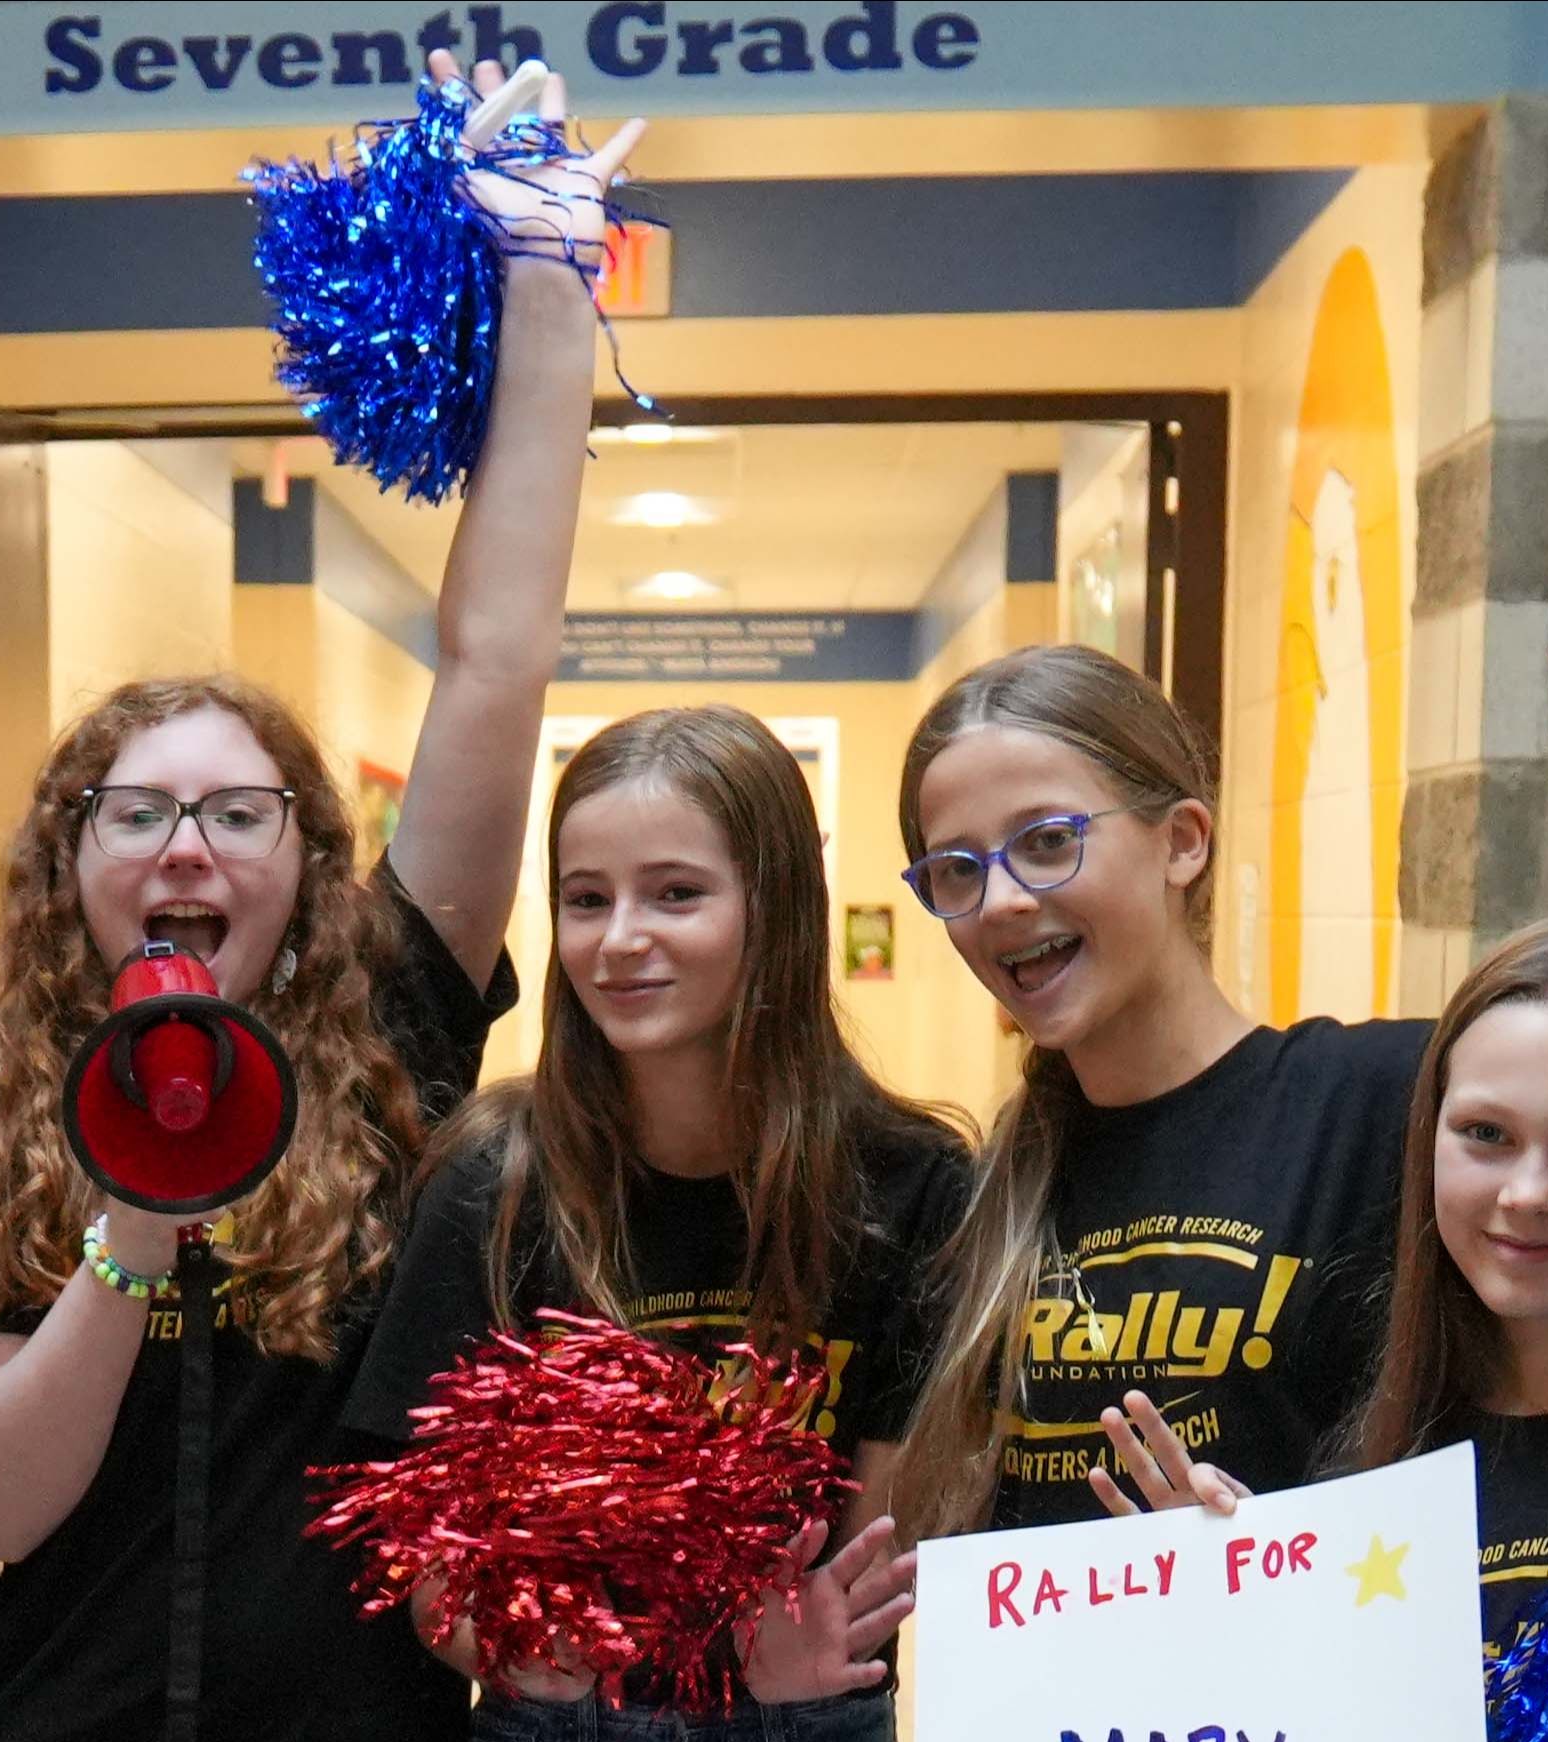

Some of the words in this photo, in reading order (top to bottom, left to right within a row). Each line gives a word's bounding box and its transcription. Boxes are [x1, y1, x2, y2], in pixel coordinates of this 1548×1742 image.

[42, 0, 546, 96] Seventh
[586, 0, 981, 80] Grade
[1126, 1215, 1179, 1242] CANCER
[1180, 1216, 1264, 1245] RESEARCH
[627, 1291, 696, 1318] ILDHOOD
[700, 1291, 753, 1309] CANCR
[1025, 1254, 1302, 1378] Rally!
[1031, 1364, 1170, 1381] UNDATION
[988, 1549, 1176, 1628] RALLY
[1226, 1532, 1318, 1595] FOR
